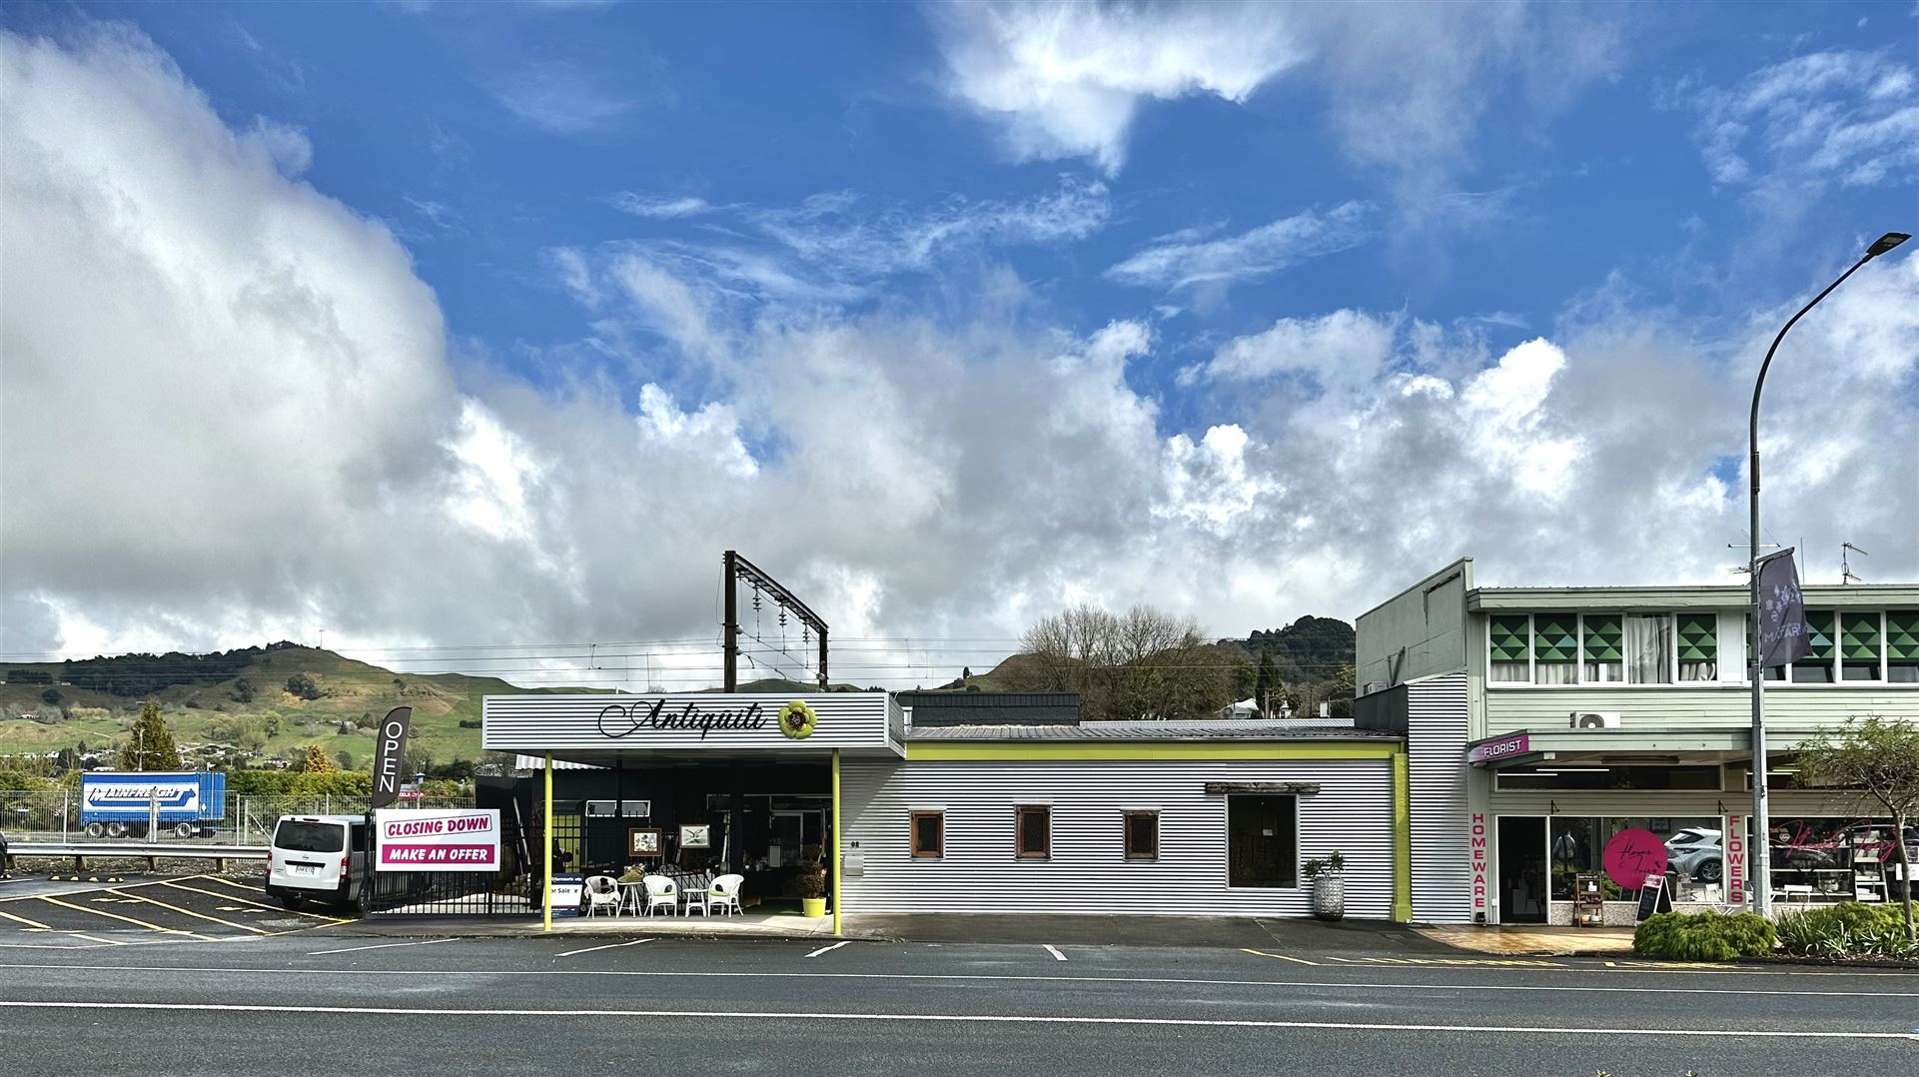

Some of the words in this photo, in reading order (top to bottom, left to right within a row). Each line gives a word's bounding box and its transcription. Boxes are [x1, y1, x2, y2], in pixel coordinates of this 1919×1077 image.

[378, 722, 403, 793] OPEN
[1483, 739, 1522, 757] FLORIST
[388, 820, 443, 837] CLOSING
[447, 817, 489, 832] DOWN
[389, 849, 426, 861] MAKE
[428, 849, 446, 861] AN
[449, 849, 488, 861] OFFER
[1471, 813, 1487, 908] HOMEWARE
[1728, 815, 1744, 903] FLOWERS
